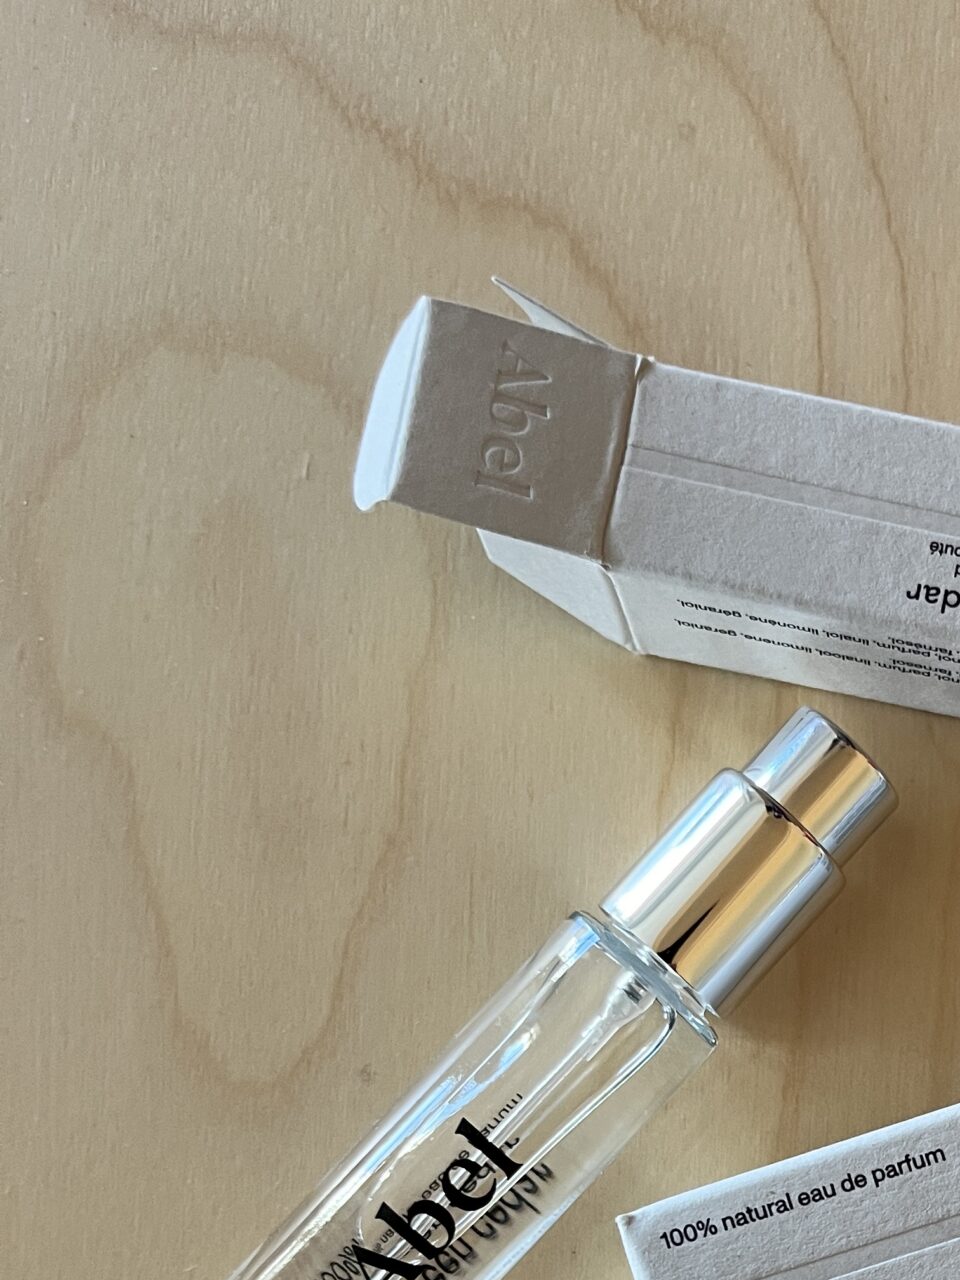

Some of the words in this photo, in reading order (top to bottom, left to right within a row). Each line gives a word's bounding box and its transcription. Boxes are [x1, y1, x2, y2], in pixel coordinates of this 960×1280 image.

[473, 338, 552, 499] Abel
[660, 1217, 718, 1249] 100%
[721, 1193, 794, 1232] natural
[798, 1183, 837, 1207] eau
[840, 1172, 868, 1193] de
[871, 1148, 947, 1187] parfum
